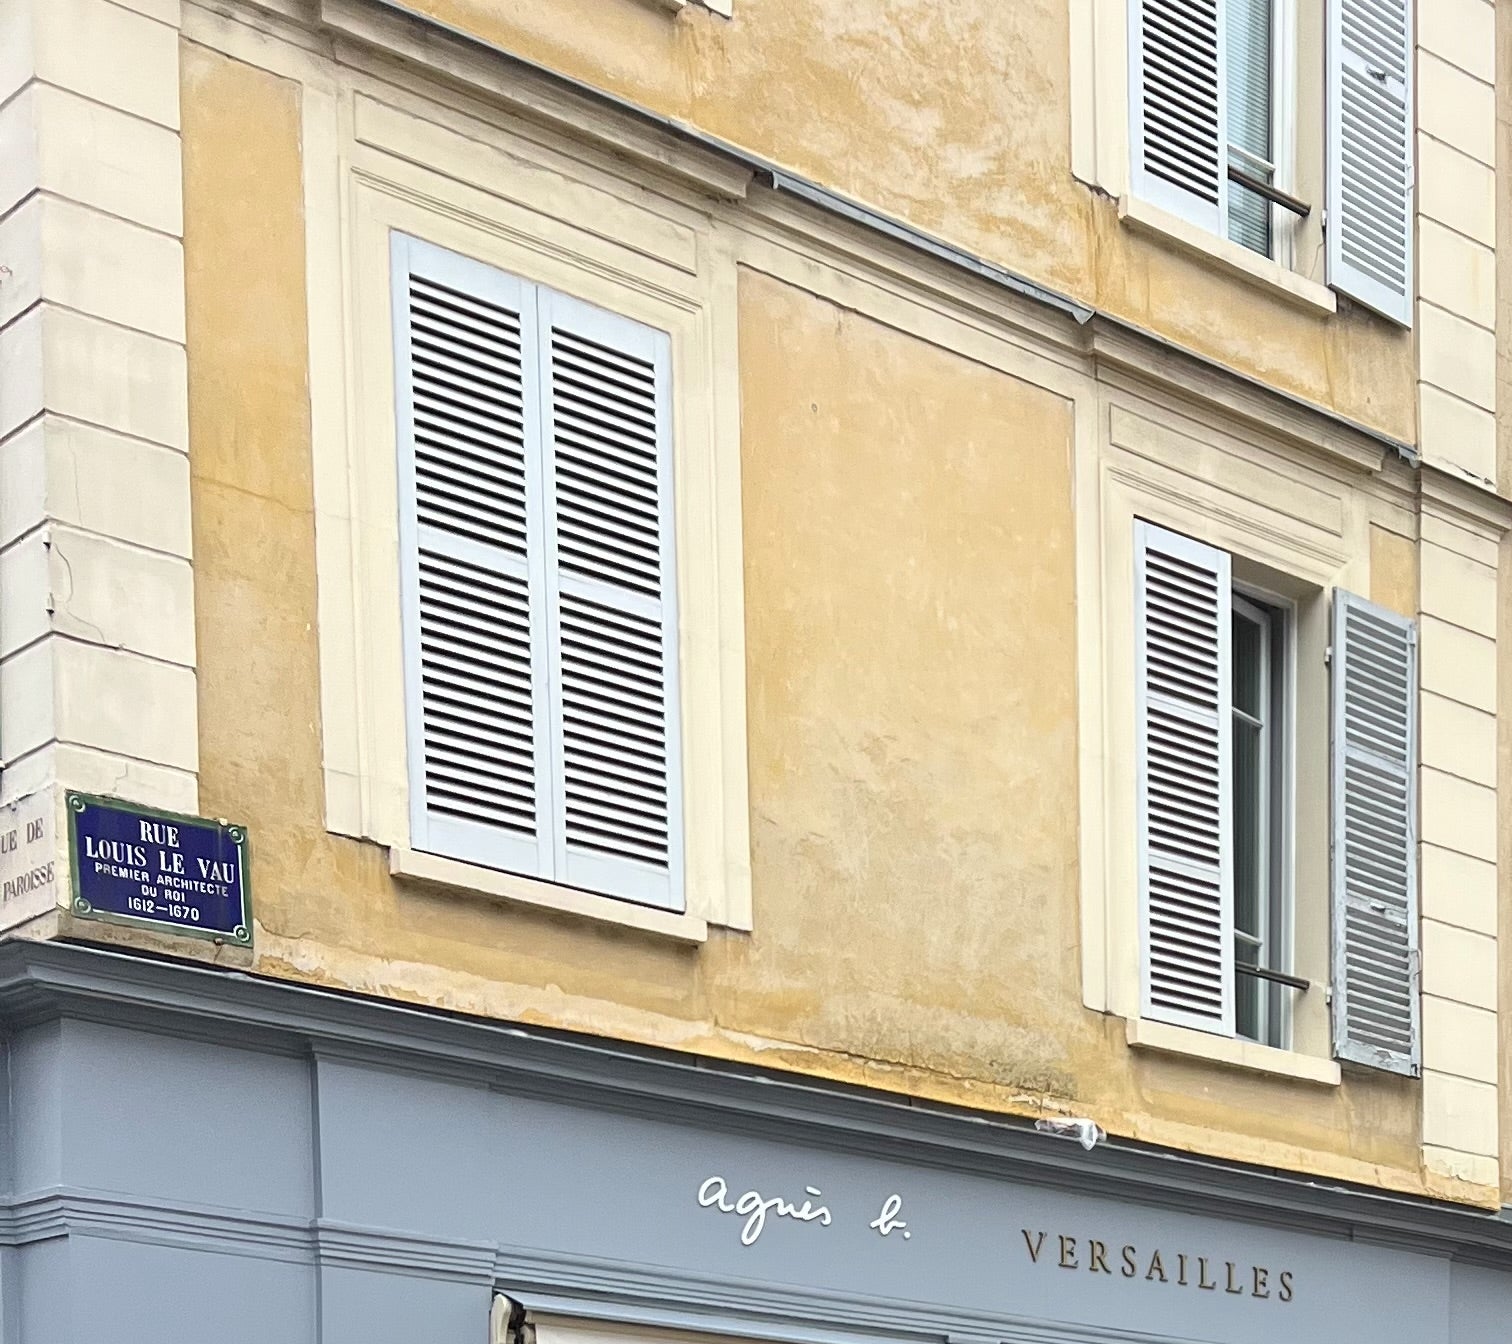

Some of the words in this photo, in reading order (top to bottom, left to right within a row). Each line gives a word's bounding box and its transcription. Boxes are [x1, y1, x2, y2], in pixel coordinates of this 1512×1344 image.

[0, 829, 18, 854] UE
[26, 817, 44, 844] DE
[139, 819, 180, 848] RUE
[85, 836, 147, 867] LOUIS
[159, 850, 185, 875] LE
[196, 857, 235, 883] VAU
[95, 861, 150, 882] PREMIER
[156, 874, 229, 897] ARCHITECTE
[3, 860, 55, 902] PAROISSE
[141, 885, 157, 898] DU
[164, 889, 186, 903] ROI
[697, 1176, 832, 1246] agnès
[869, 1193, 912, 1239] b.
[1021, 1229, 1295, 1302] VERSAILLES
